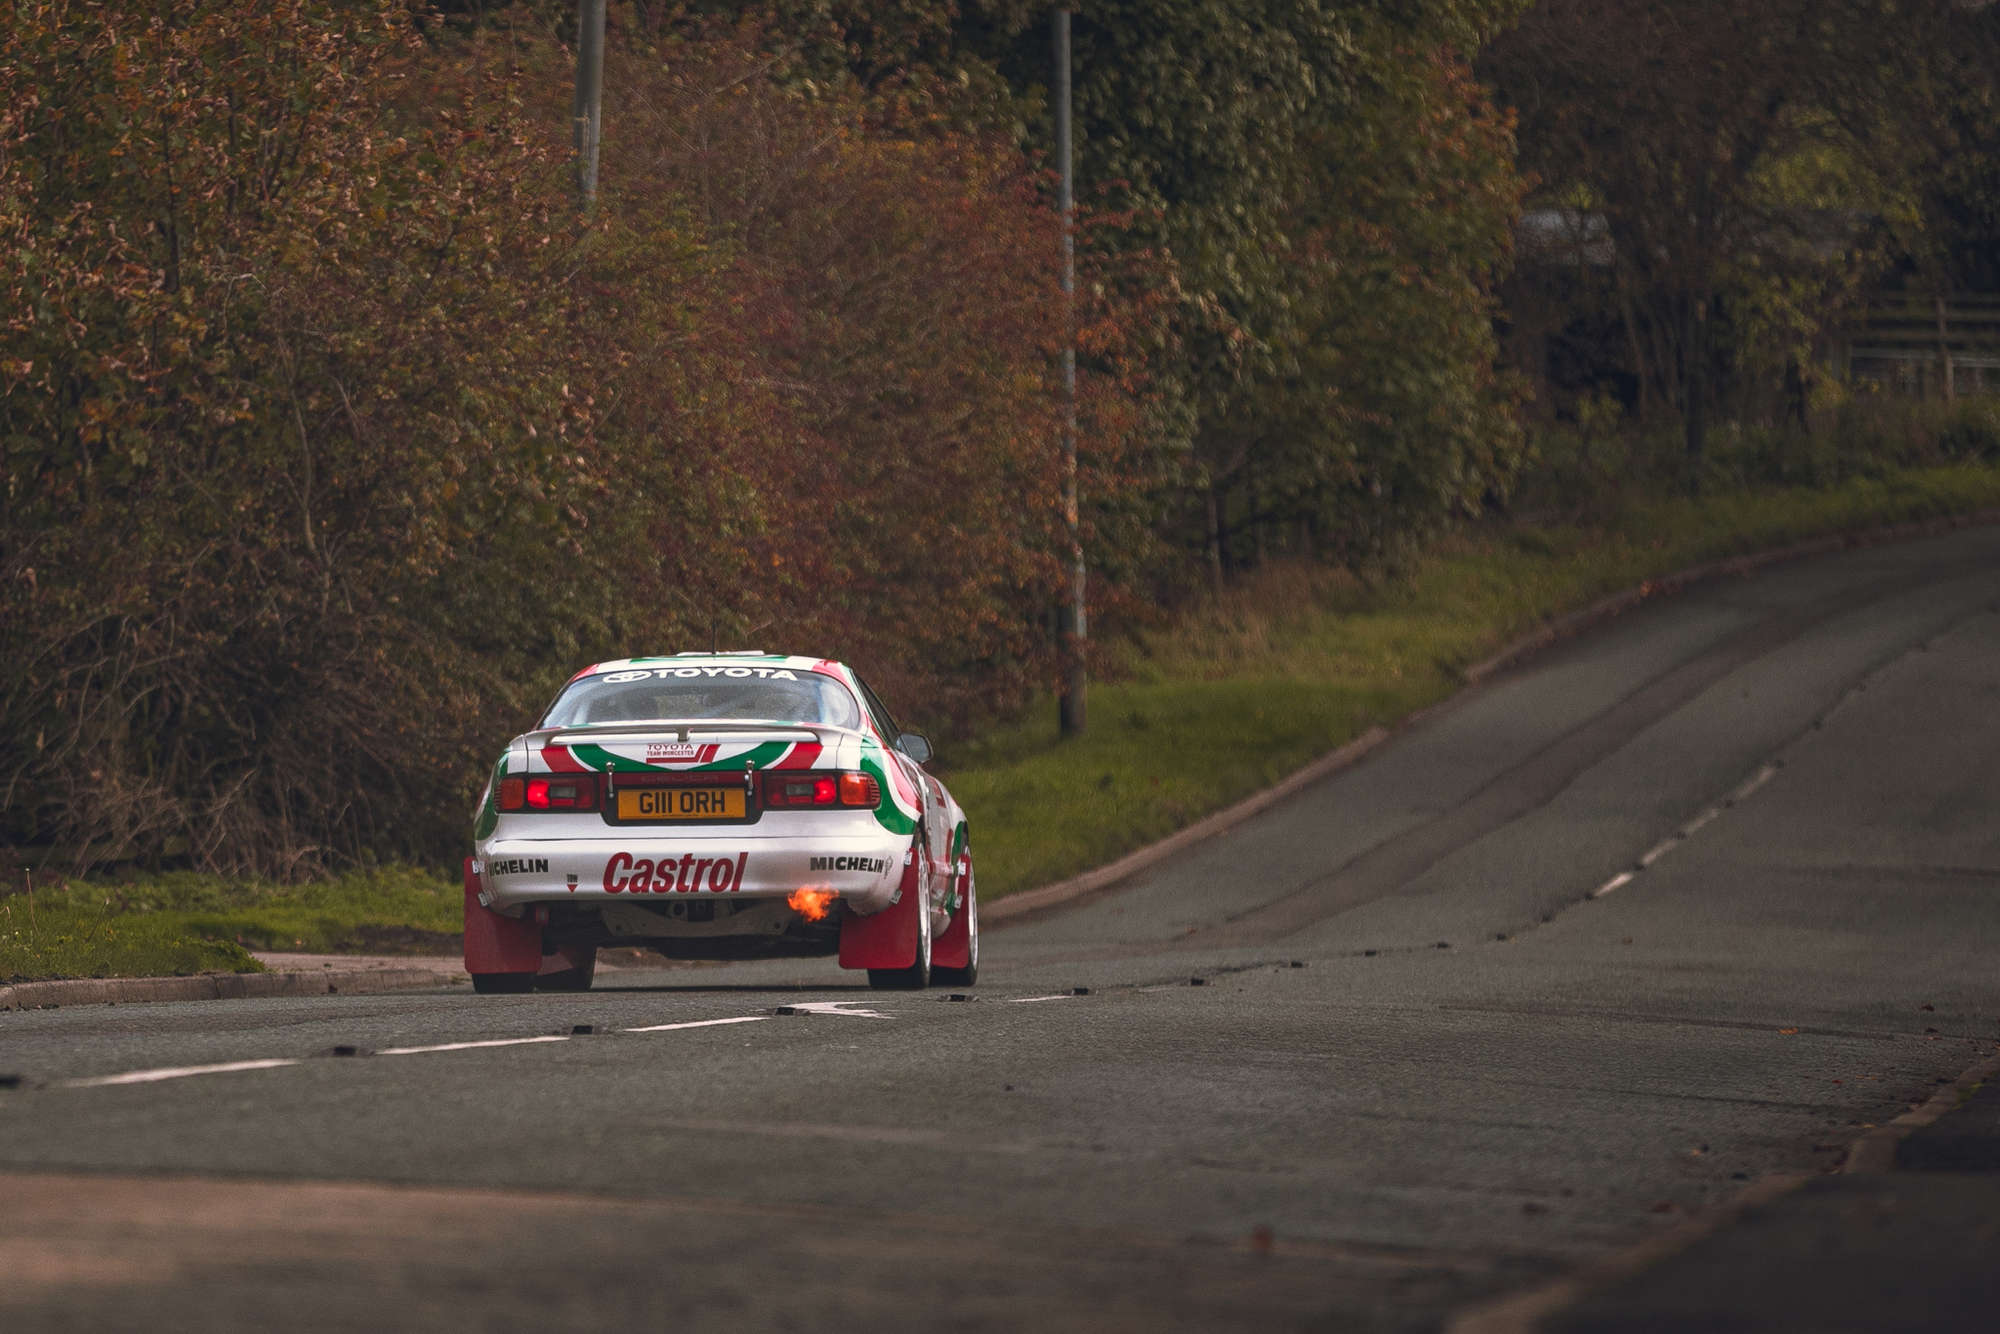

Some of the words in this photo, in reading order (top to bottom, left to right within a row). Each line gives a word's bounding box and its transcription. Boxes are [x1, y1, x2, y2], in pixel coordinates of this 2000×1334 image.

[654, 667, 798, 681] TOYOTA
[647, 743, 693, 751] TOYOTA
[680, 791, 725, 813] ORH
[602, 851, 749, 894] Castrol
[810, 856, 884, 873] MICHELIN
